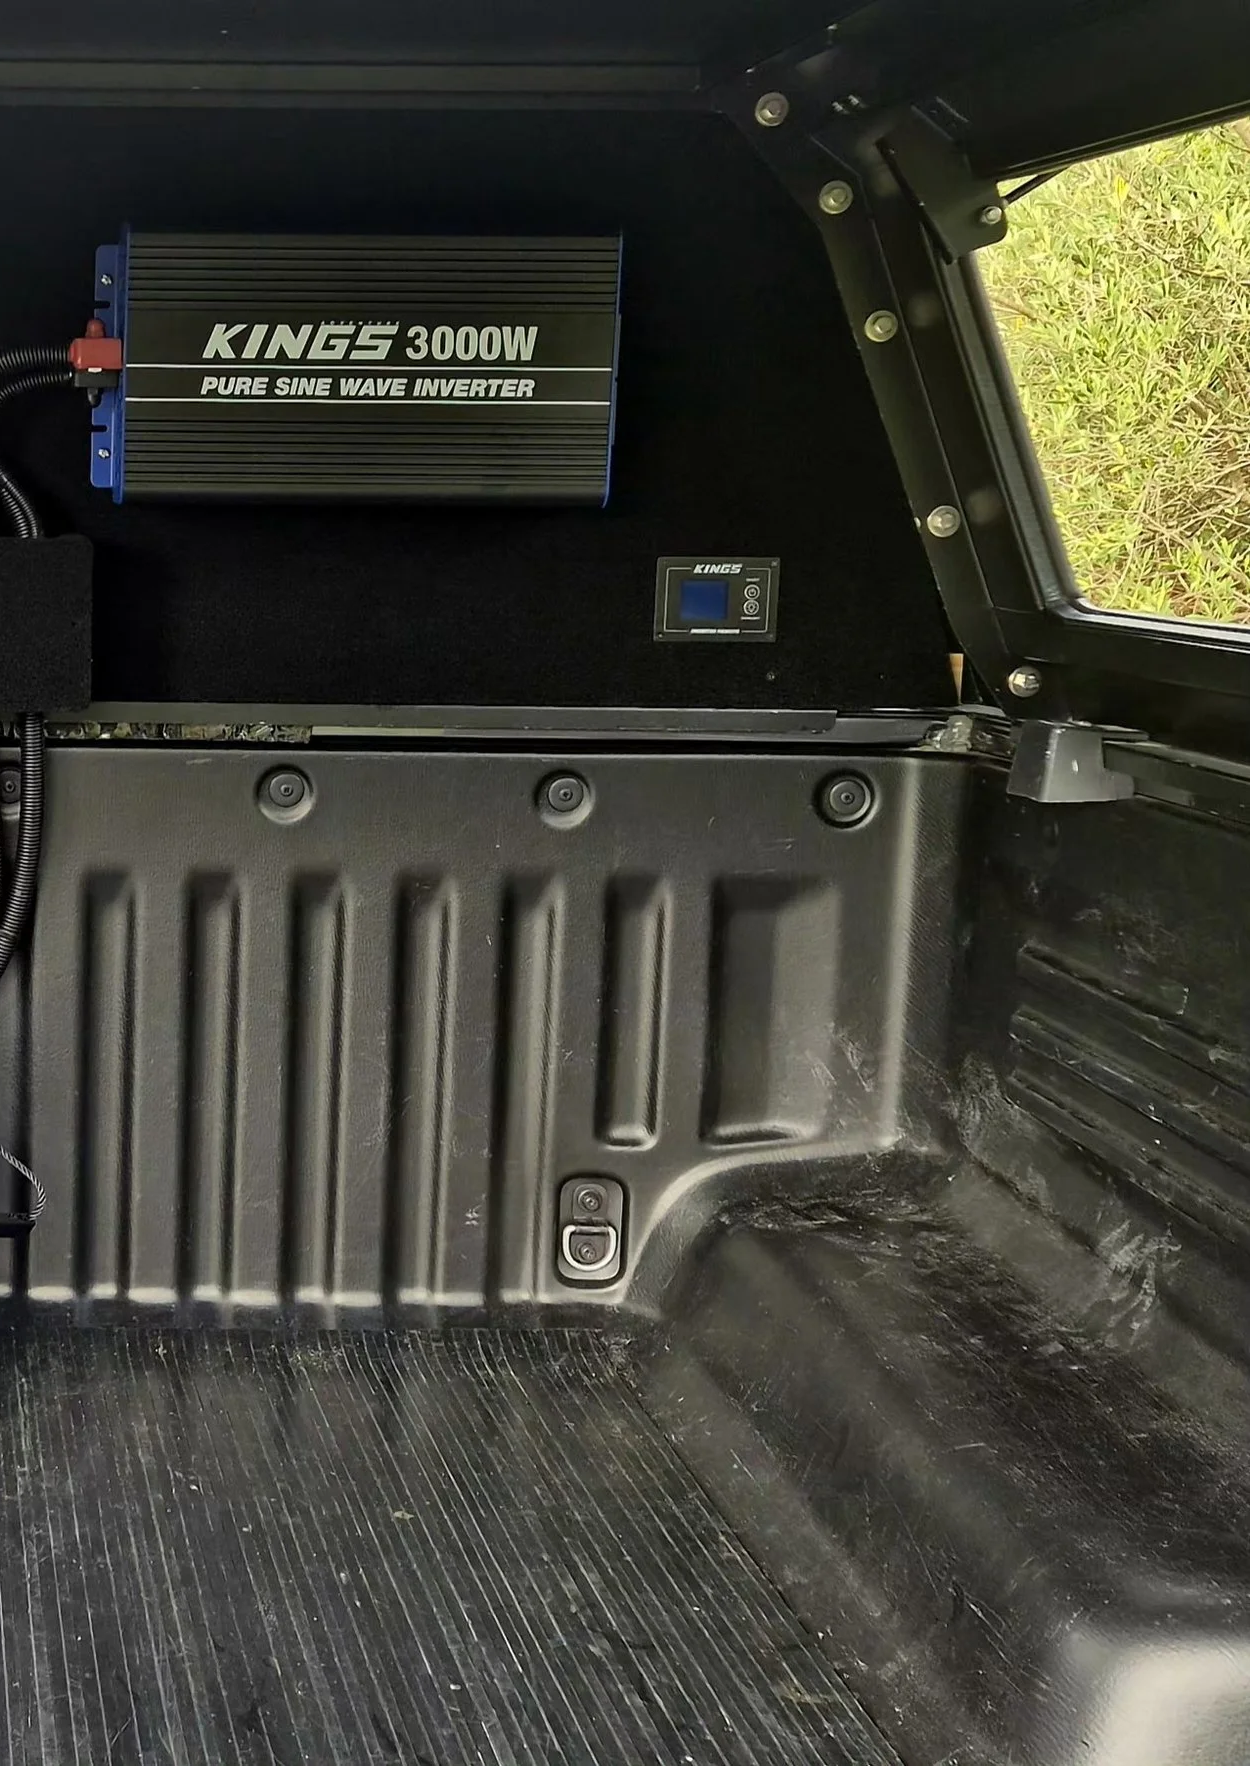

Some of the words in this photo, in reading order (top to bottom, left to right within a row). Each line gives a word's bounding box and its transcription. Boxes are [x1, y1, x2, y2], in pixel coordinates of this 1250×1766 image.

[202, 323, 400, 360] KINGS
[405, 325, 539, 362] 3000W
[200, 376, 269, 396] PURE
[274, 377, 332, 396] SINE
[339, 378, 406, 397] WAVE
[413, 378, 536, 398] INVERTER
[693, 563, 743, 574] KINGS
